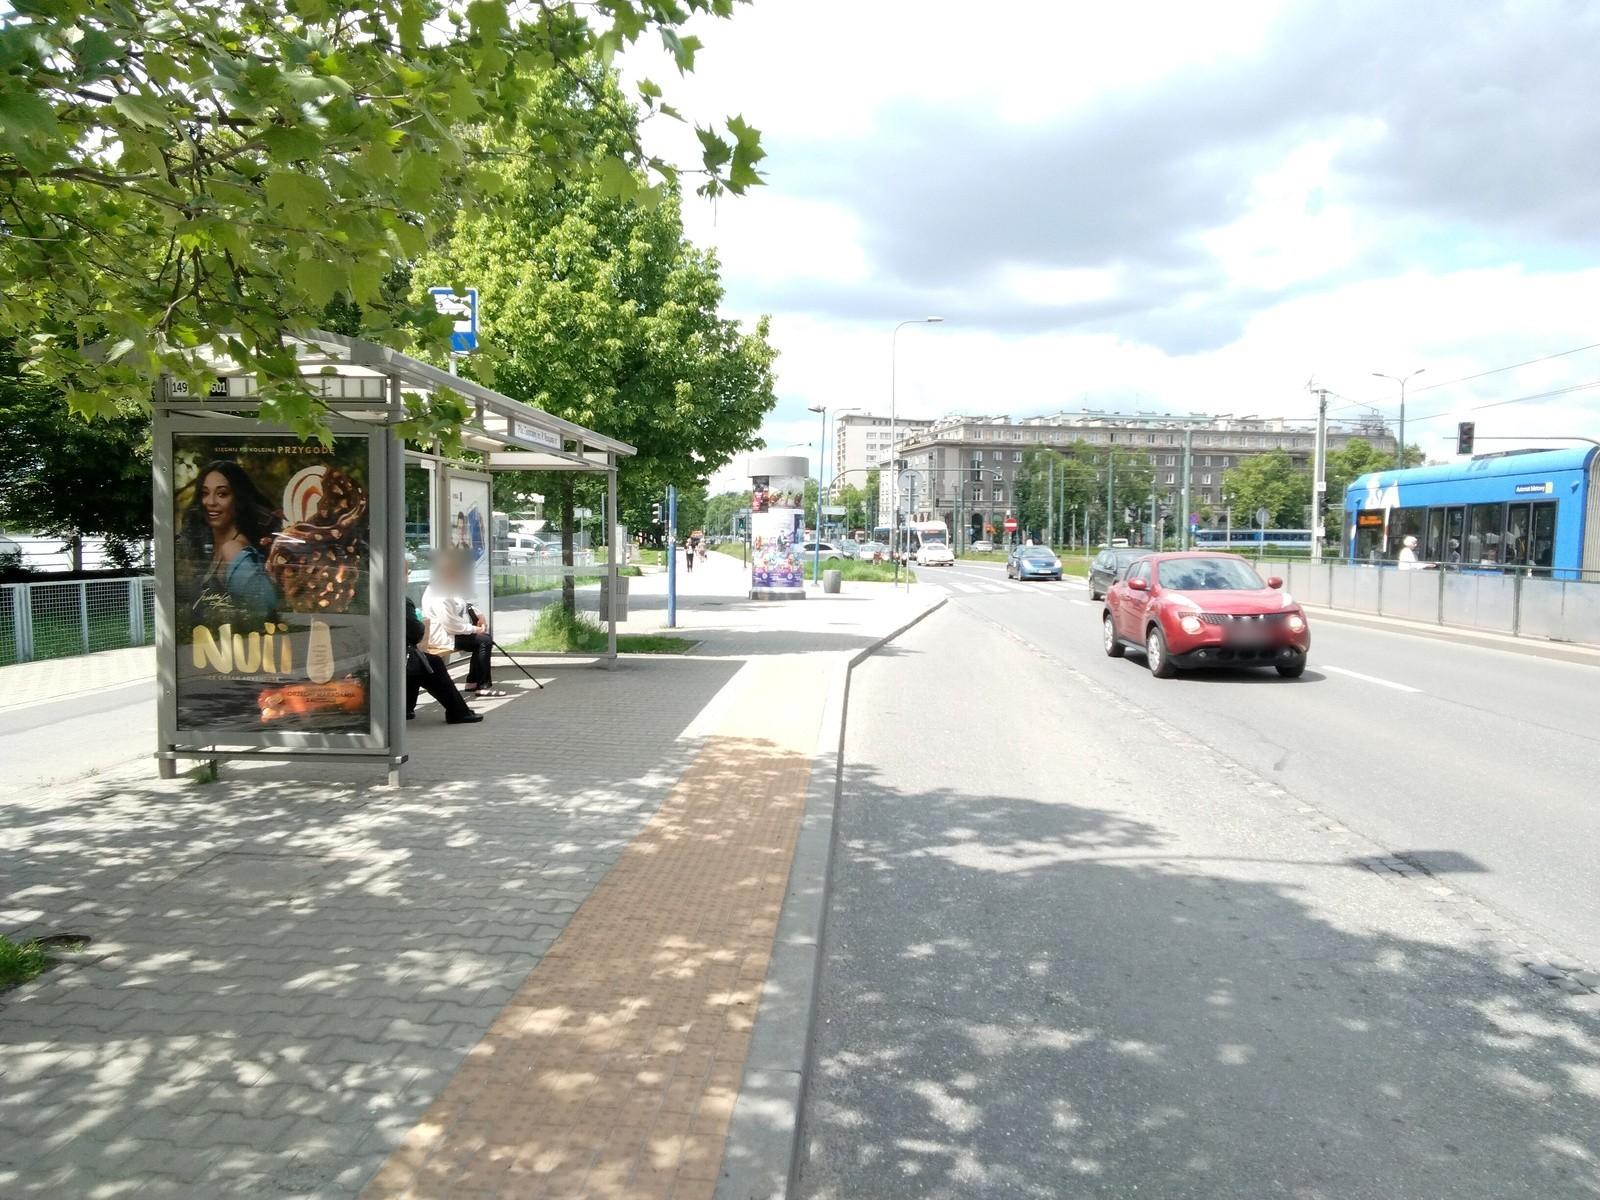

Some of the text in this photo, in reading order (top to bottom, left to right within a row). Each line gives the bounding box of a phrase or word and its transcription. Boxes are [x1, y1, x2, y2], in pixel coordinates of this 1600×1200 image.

[172, 382, 188, 392] 149
[277, 446, 336, 457] PRZYGODĘ
[193, 622, 292, 674] Nuii
